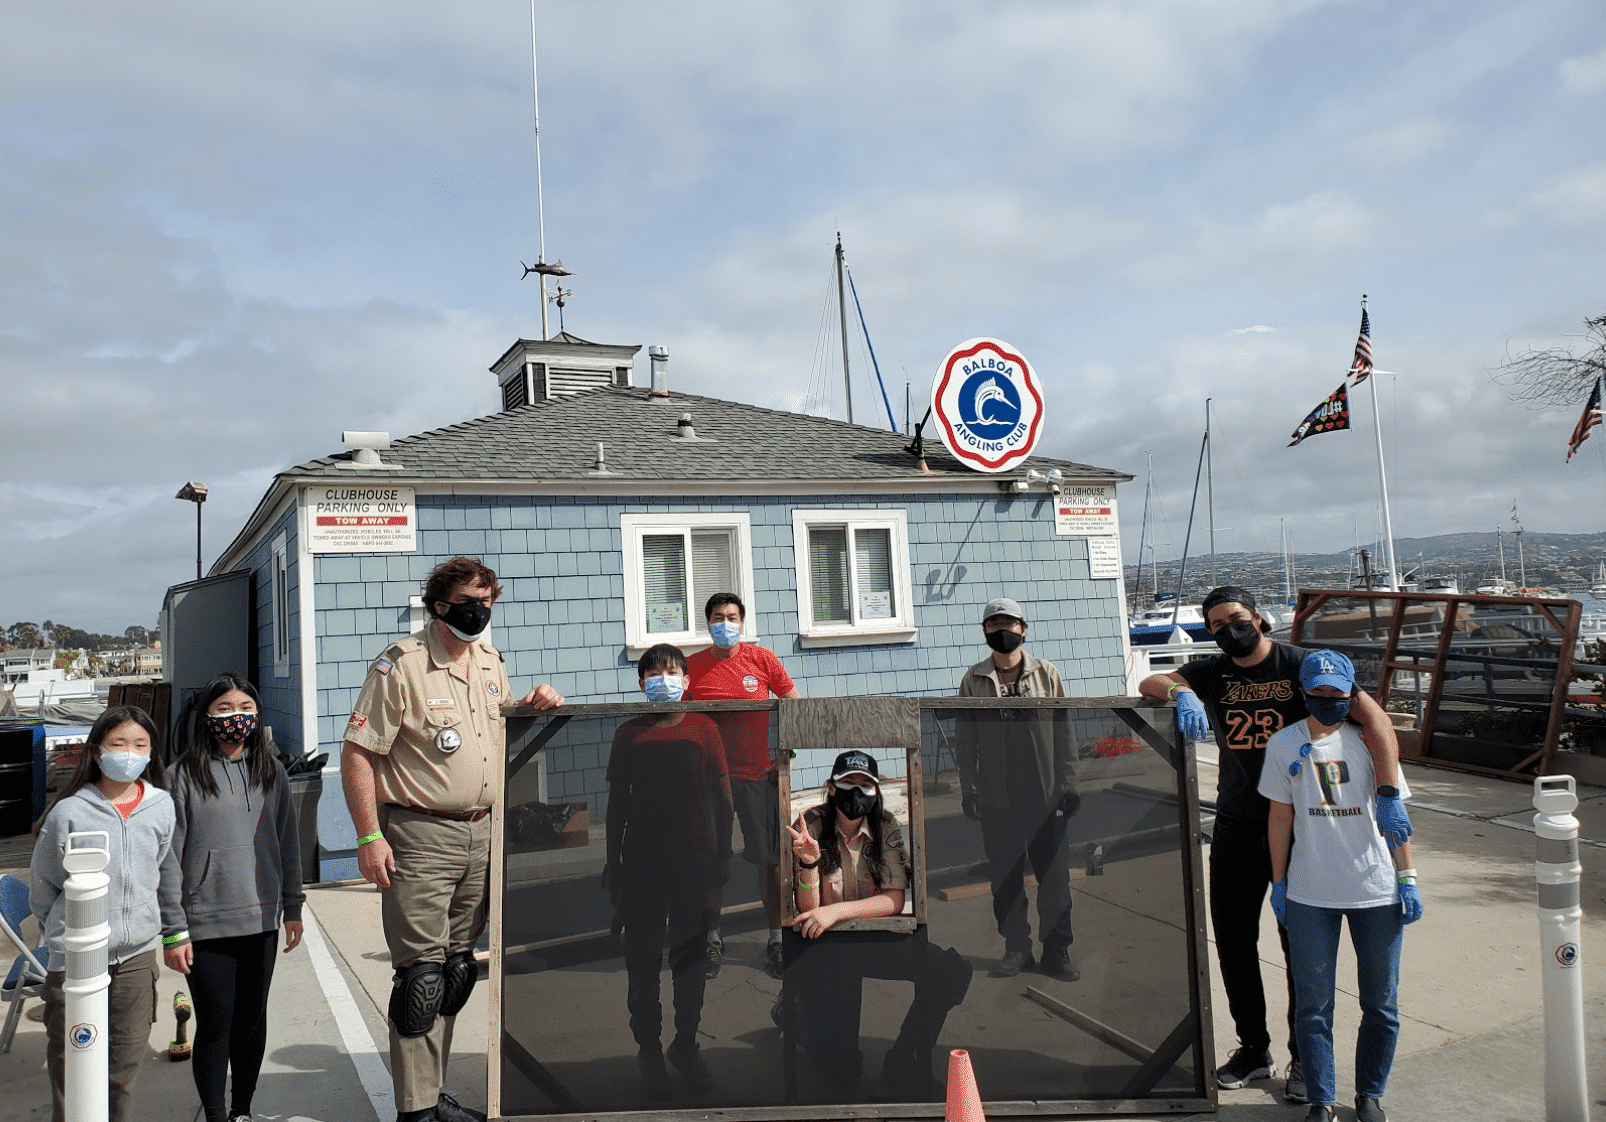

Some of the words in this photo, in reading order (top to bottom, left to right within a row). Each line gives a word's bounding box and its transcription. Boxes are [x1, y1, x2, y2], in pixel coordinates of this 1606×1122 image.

[962, 358, 1013, 377] BALBOA
[953, 422, 1004, 451] ANGLING
[1006, 422, 1028, 446] CLUB
[325, 489, 399, 500] CLUBHOUSE
[1063, 487, 1105, 496] CLUBHOUSE
[316, 502, 370, 513] PARKING
[377, 502, 408, 513] ONLY
[1059, 497, 1090, 505] PARKING
[1093, 497, 1111, 505] ONLY
[335, 517, 359, 525] TOW
[361, 517, 391, 525] AWAY
[1320, 657, 1335, 673] LA
[1220, 680, 1293, 704] LAKERS
[1226, 709, 1284, 749] 23
